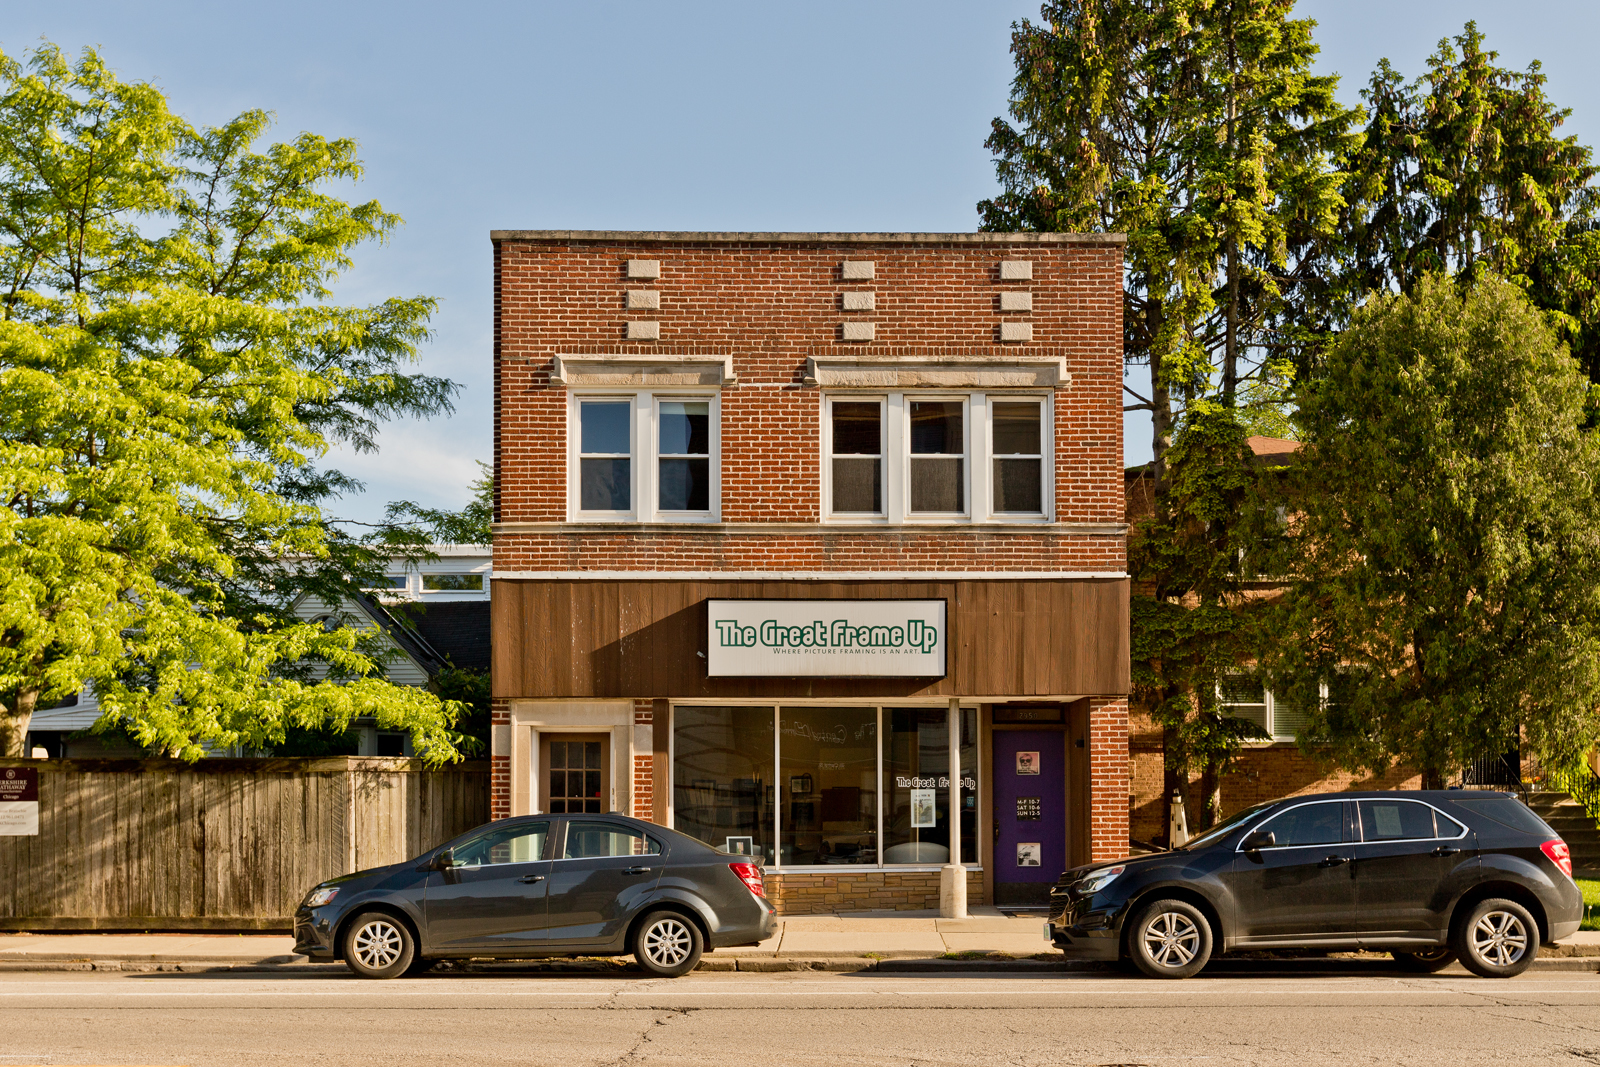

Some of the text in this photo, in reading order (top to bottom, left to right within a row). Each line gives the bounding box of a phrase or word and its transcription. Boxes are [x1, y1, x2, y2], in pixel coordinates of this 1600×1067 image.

[715, 619, 938, 654] The Great Frame Up
[772, 647, 801, 655] WHERE
[896, 776, 911, 788] The
[911, 776, 936, 788] Great
[964, 777, 976, 791] Up
